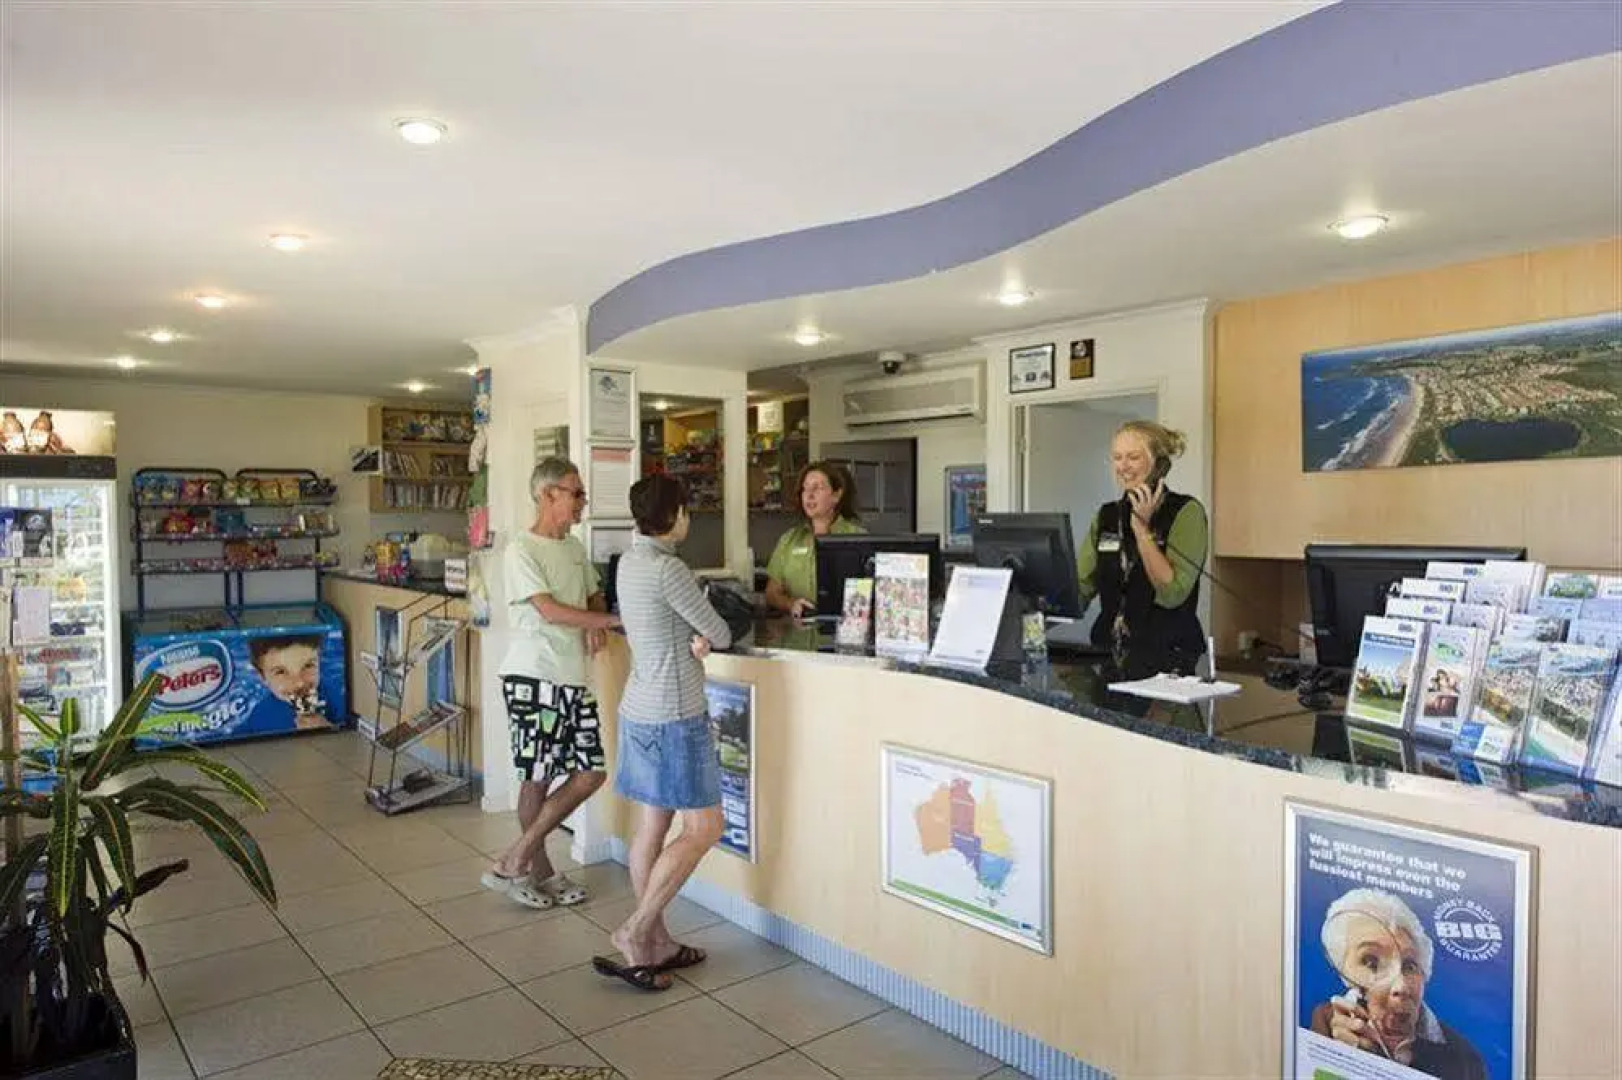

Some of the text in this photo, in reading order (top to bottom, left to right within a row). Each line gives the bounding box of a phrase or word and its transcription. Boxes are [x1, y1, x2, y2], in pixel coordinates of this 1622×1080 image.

[157, 663, 221, 695] Peters
[1308, 832, 1467, 880] We guarantee that we
[1308, 847, 1461, 892] will impress even the
[1308, 858, 1434, 899] fussiest members
[1467, 899, 1495, 923] BACK
[1434, 921, 1503, 941] BIG
